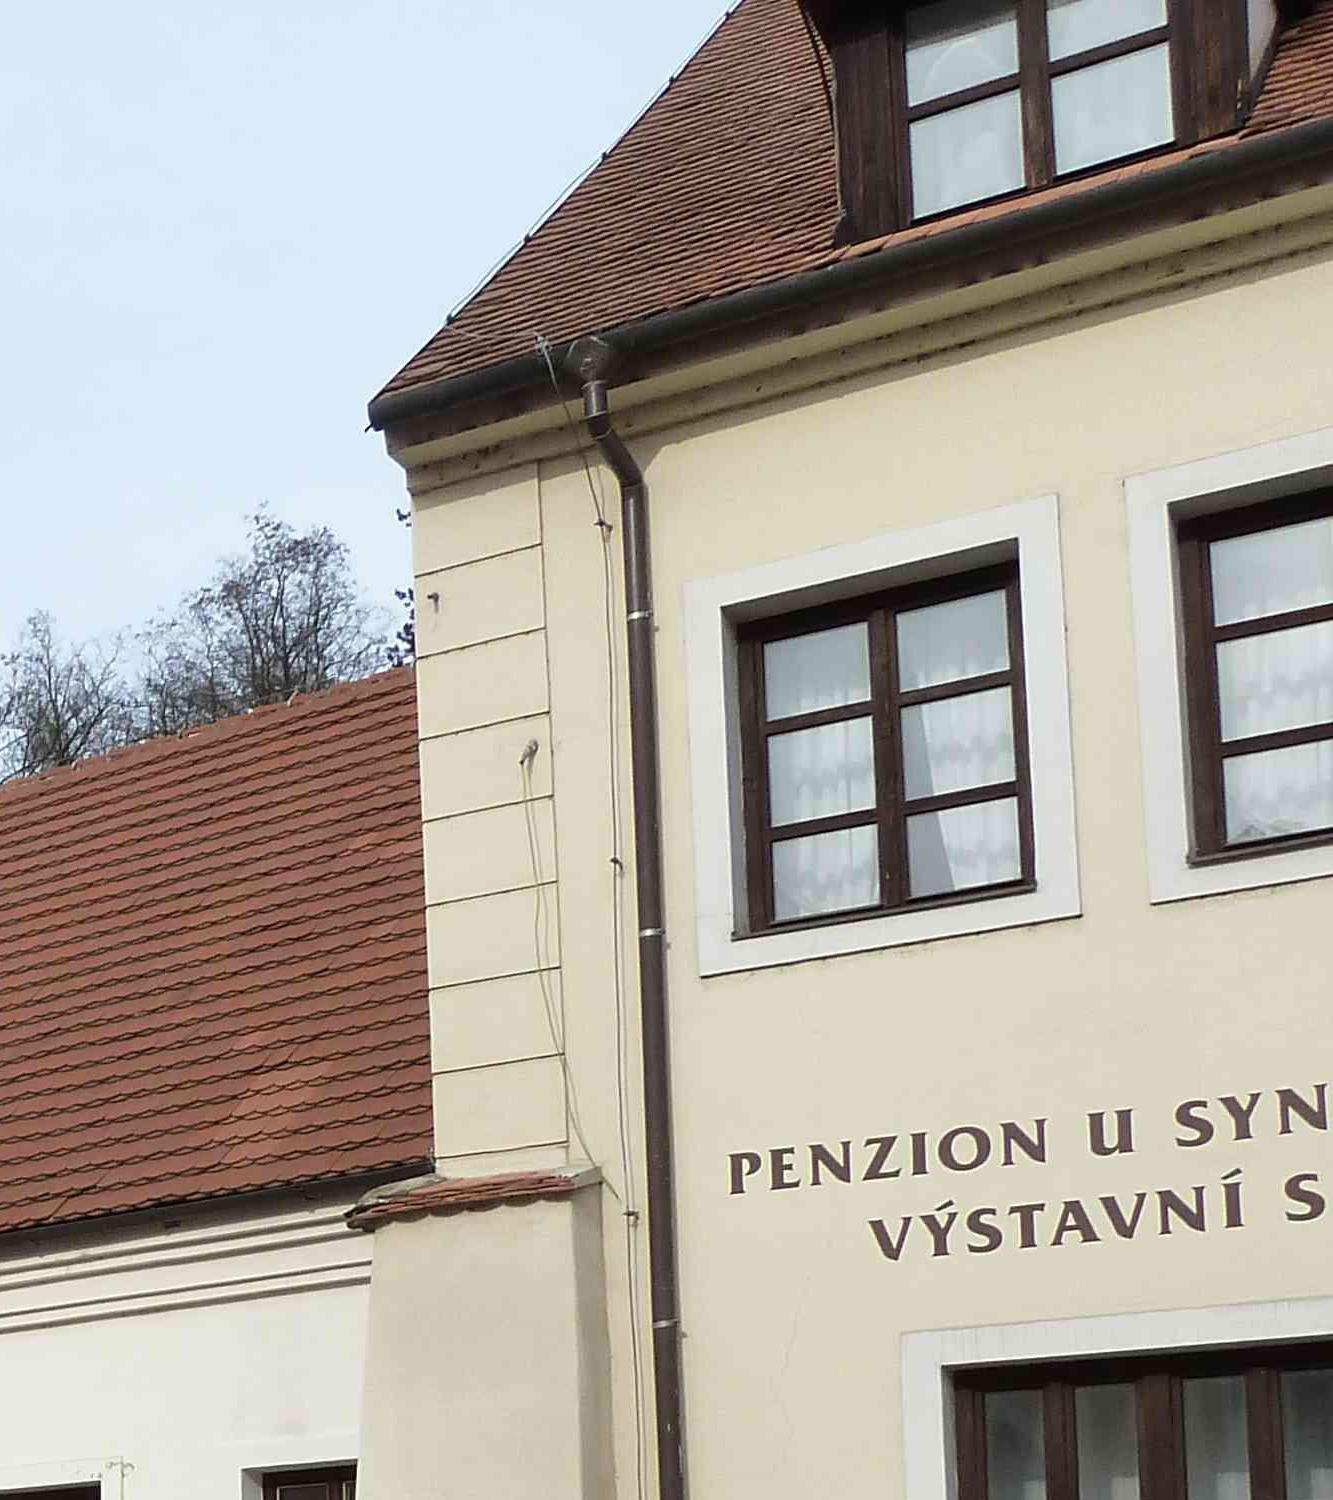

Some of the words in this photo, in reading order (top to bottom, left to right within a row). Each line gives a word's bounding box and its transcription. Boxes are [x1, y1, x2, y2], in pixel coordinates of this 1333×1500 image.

[729, 1119, 1047, 1195] PENZION
[1088, 1109, 1134, 1156] U
[869, 1168, 1244, 1261] VÝSTAVNÍ
